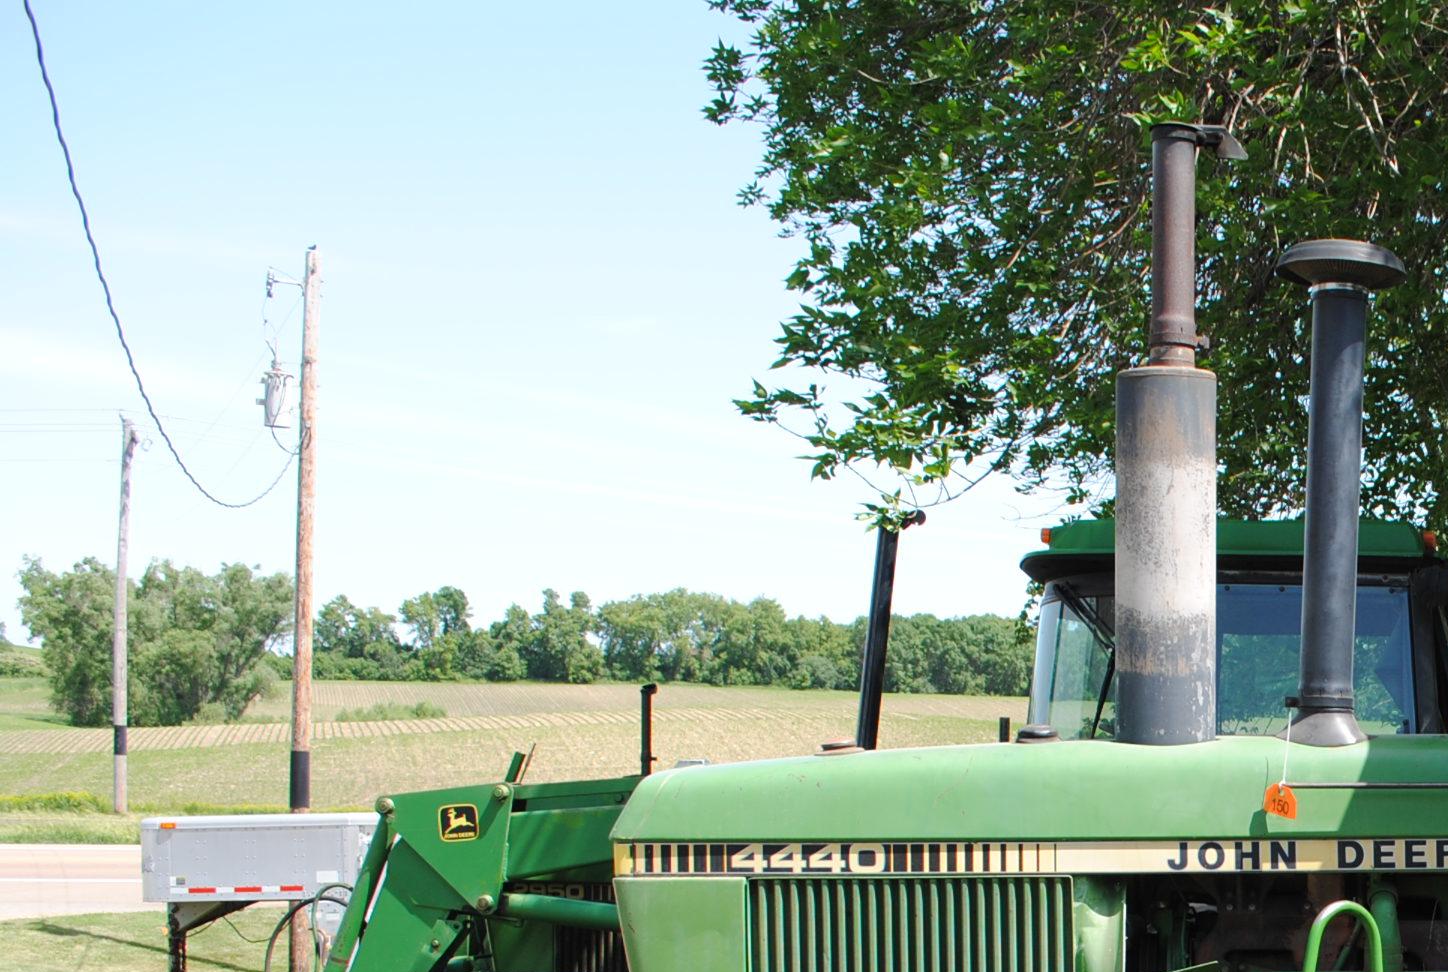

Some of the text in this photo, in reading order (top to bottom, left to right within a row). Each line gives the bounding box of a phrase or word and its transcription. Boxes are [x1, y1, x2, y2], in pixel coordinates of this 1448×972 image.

[1272, 799, 1290, 815] 150
[731, 843, 885, 873] 4440
[1167, 840, 1297, 870] JOHN
